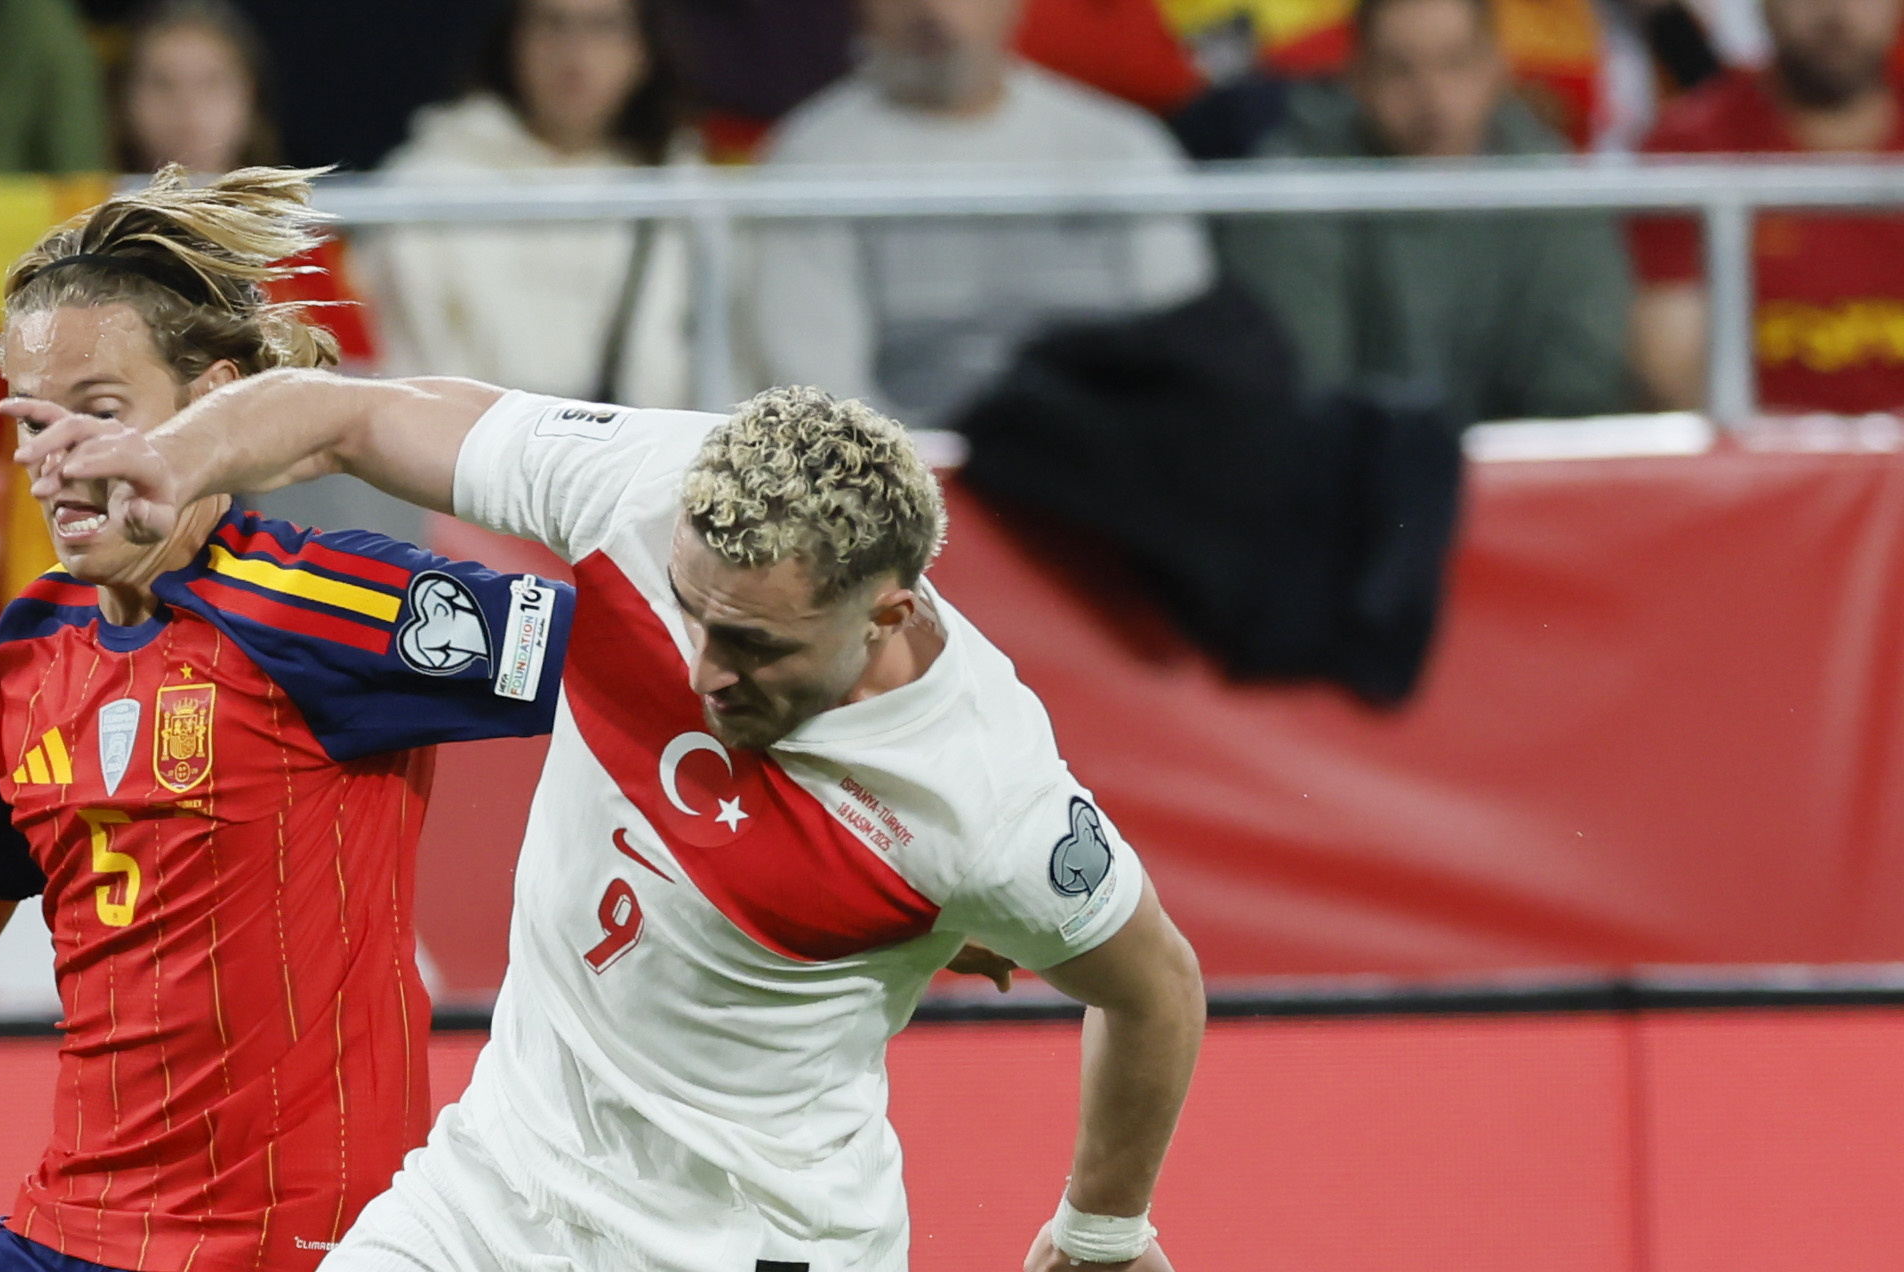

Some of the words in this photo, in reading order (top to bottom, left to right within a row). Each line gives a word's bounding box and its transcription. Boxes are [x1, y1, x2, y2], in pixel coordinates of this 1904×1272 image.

[520, 588, 542, 614] 10
[510, 615, 534, 696] FOUNDATION
[75, 808, 141, 927] 5
[870, 829, 893, 852] 2025
[583, 877, 645, 976] 9
